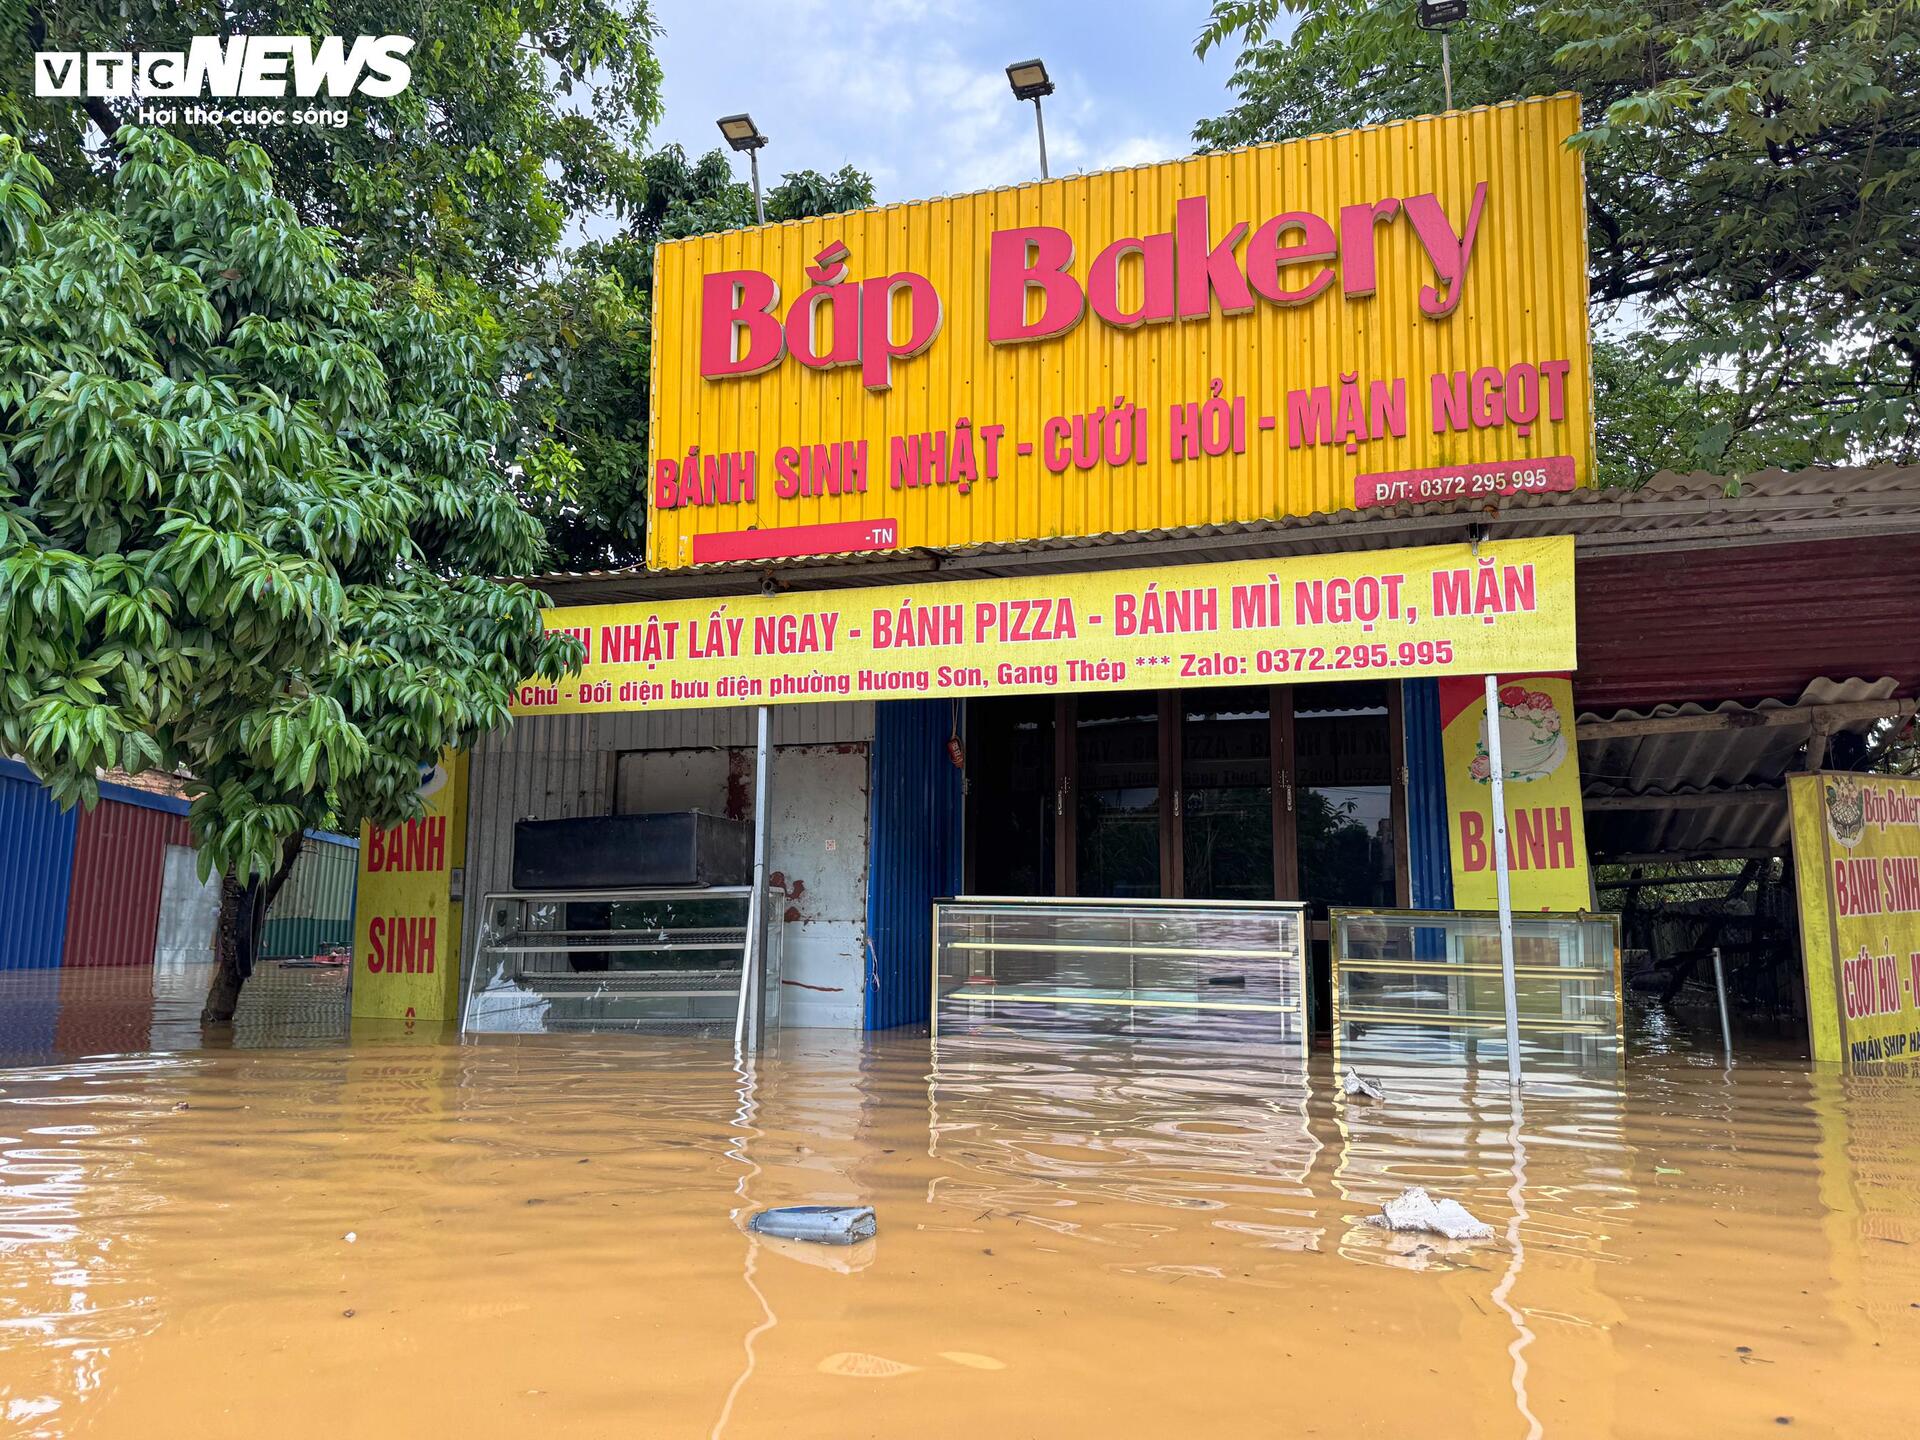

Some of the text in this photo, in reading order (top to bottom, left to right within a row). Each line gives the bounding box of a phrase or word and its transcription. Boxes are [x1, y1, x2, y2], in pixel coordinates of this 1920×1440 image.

[700, 181, 1488, 392] Bắp Bakery
[656, 446, 756, 509] BÁNH
[775, 439, 867, 498] SINH
[890, 417, 1004, 493] NHẬT
[1043, 395, 1147, 472] CƯỚI
[1171, 377, 1245, 461] HỎI
[1287, 370, 1406, 455] MẶN
[1431, 360, 1570, 437] NGỌT
[1375, 468, 1547, 501] Đ/T: 0372 295 995
[601, 615, 679, 670] NHẬT
[689, 603, 743, 659] LẤY
[754, 612, 839, 656] NGAY
[872, 598, 963, 649] BÁNH
[975, 598, 1076, 644] PIZZA
[1114, 583, 1217, 636] BÁNH
[1232, 574, 1281, 628] MÌ
[1296, 575, 1417, 632] NGỌT,
[1432, 558, 1536, 624] MẶN
[521, 684, 558, 706] Chú
[578, 679, 612, 704] Đối
[619, 680, 664, 705] diện
[671, 680, 709, 699] bưu
[717, 675, 763, 701] điện
[769, 670, 849, 697] phường
[858, 669, 929, 694] Hương
[938, 664, 988, 687] Sơn,
[998, 662, 1057, 686] Gang
[1066, 657, 1125, 683] Thép
[1181, 653, 1247, 677] Zalo:
[1257, 640, 1454, 673] 0372.295.995
[1864, 784, 1887, 831] Bắp
[1883, 858, 1920, 913] SINH
[368, 917, 437, 974] SINH
[1844, 946, 1876, 1019] CƯỚI
[1878, 937, 1901, 1013] HỎI
[1852, 1035, 1883, 1062] NHÂN
[1883, 1034, 1906, 1058] SHIP
